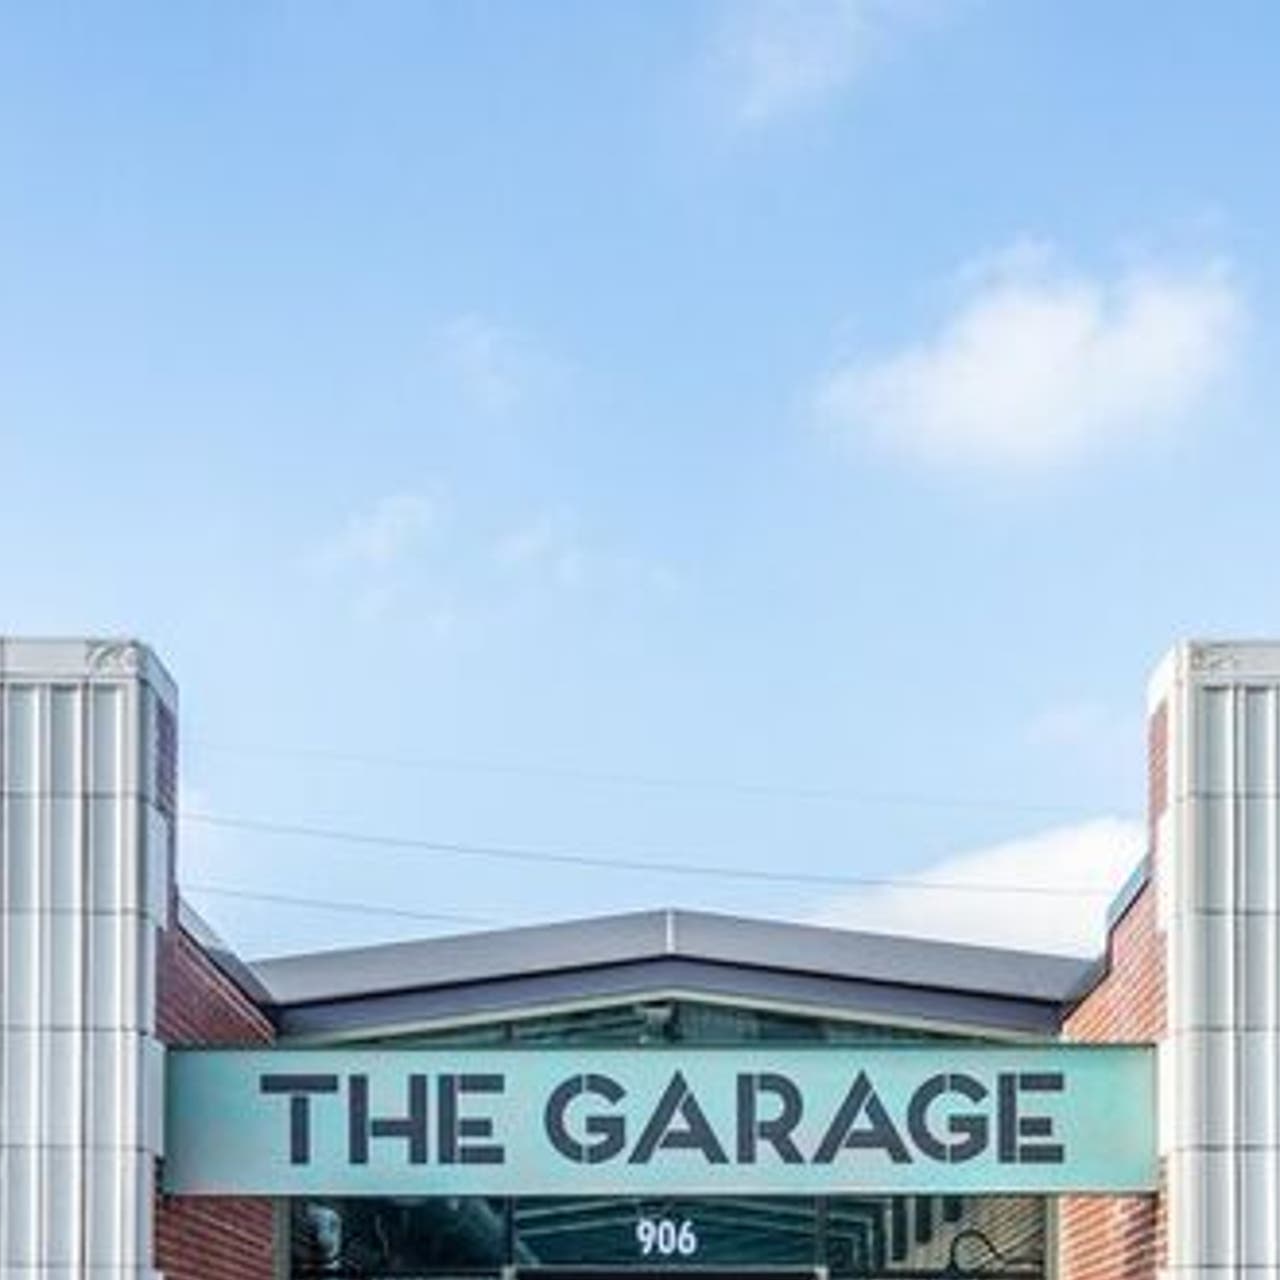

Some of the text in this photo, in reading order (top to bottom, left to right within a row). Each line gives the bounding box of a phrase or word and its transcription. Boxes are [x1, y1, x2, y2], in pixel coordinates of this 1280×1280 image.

[260, 1070, 1064, 1165] THE GARAGE
[636, 1219, 697, 1256] 906
